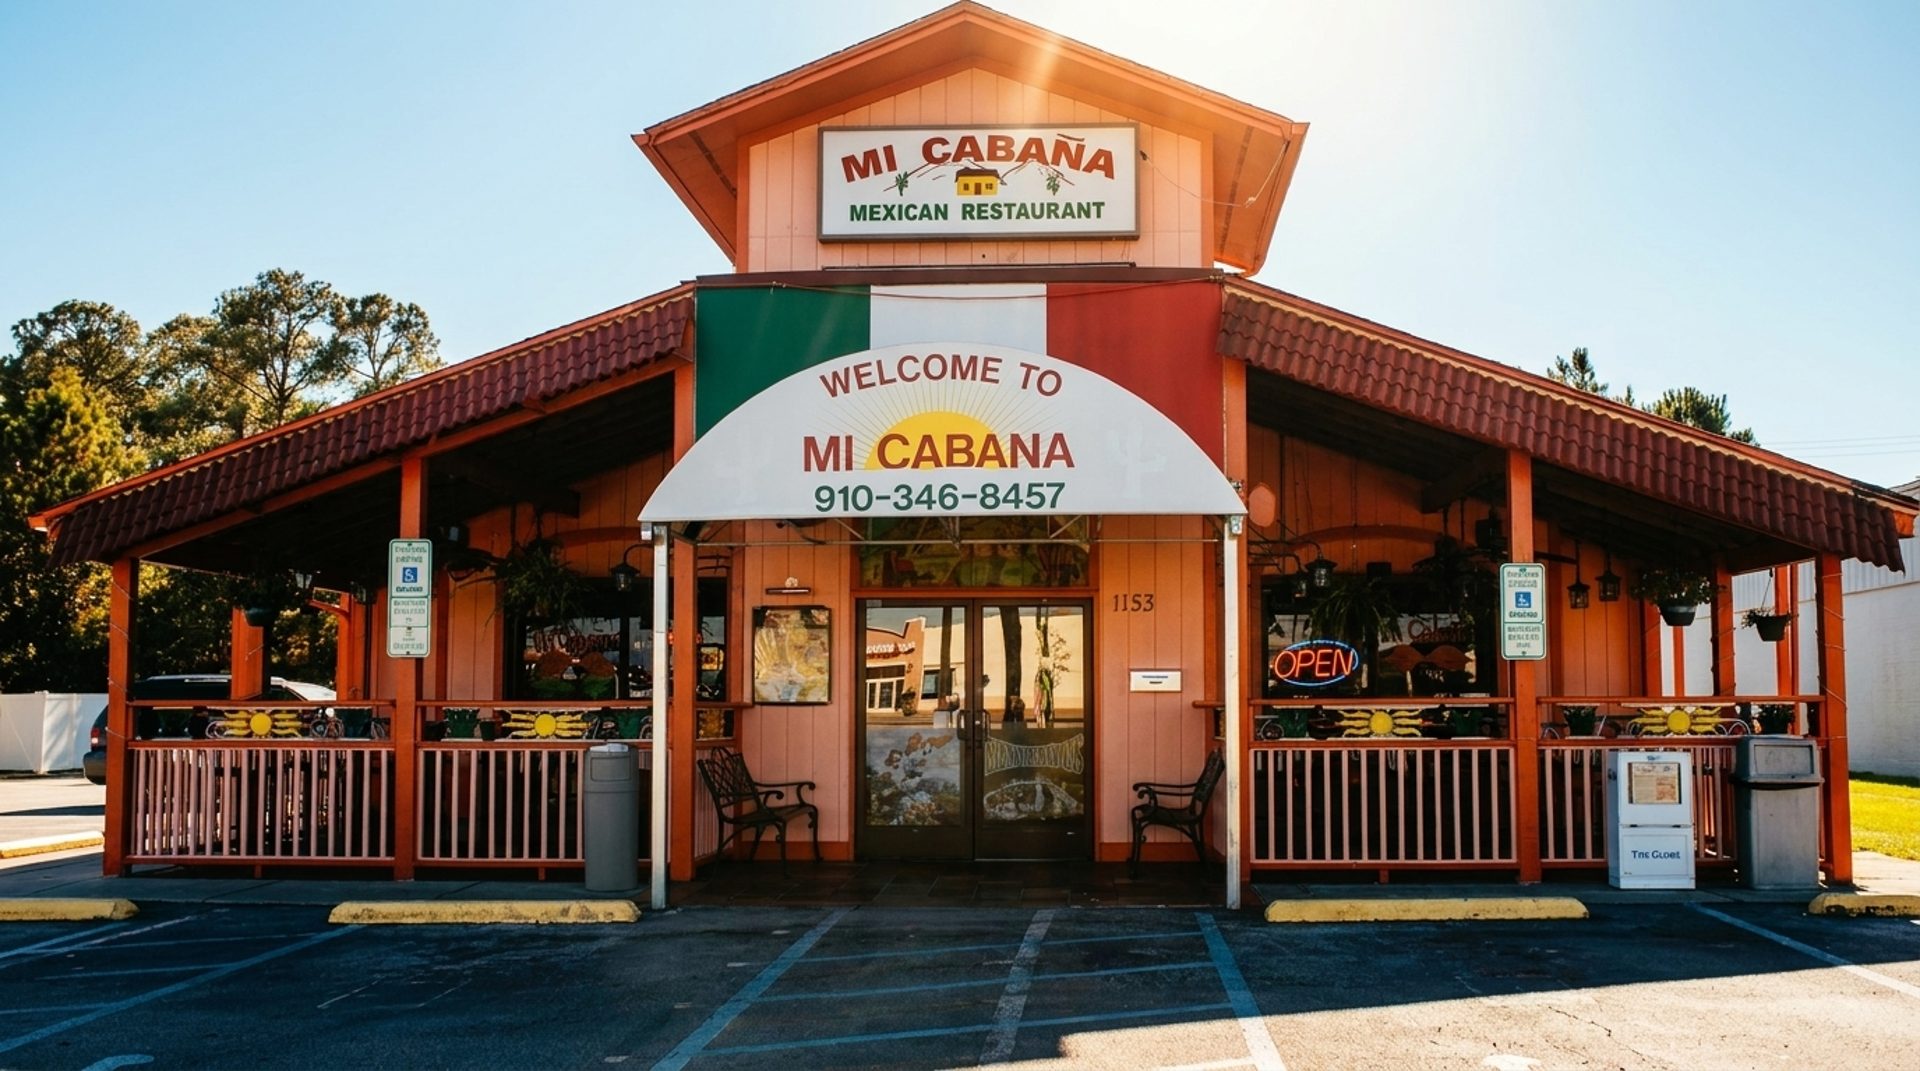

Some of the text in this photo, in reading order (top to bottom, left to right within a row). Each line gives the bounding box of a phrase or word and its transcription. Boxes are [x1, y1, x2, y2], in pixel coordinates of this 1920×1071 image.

[841, 133, 1115, 183] MI CABAÑA
[849, 201, 1105, 222] MEXICAN RESTAURANT
[819, 353, 1063, 398] WELCOME TO
[803, 432, 1075, 472] MI CABANA
[814, 482, 1066, 513] 910-346-8457
[1113, 593, 1154, 612] 1153
[1274, 648, 1355, 679] OPEN
